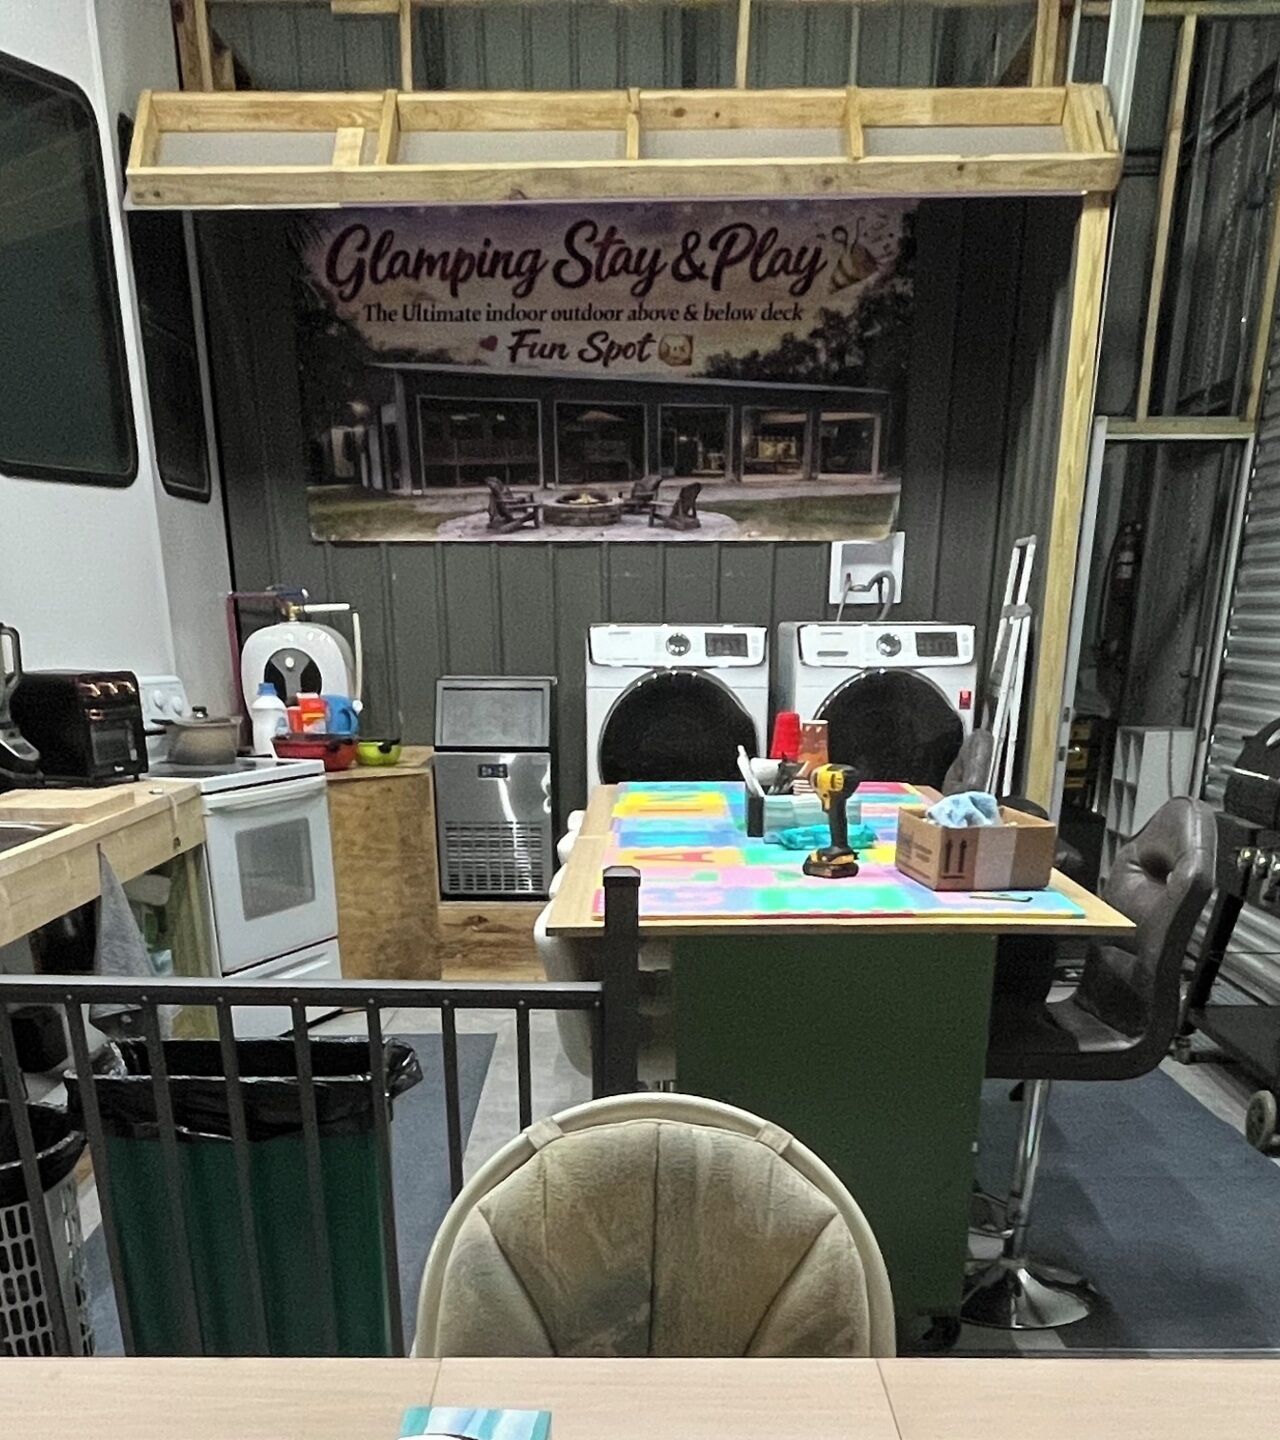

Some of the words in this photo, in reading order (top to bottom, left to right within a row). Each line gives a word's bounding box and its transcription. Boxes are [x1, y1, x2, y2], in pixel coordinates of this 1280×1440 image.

[324, 222, 549, 302] Glamping
[552, 218, 666, 297] Stay
[706, 222, 827, 297] Play
[363, 304, 397, 322] The
[402, 302, 481, 323] Ultimate
[485, 302, 546, 323] indoor
[550, 304, 623, 323] outdoor
[628, 304, 678, 323] above
[683, 305, 698, 322] &
[703, 304, 756, 323] below
[760, 304, 803, 323] deck
[507, 329, 570, 364] Fun
[577, 331, 653, 368] Spot
